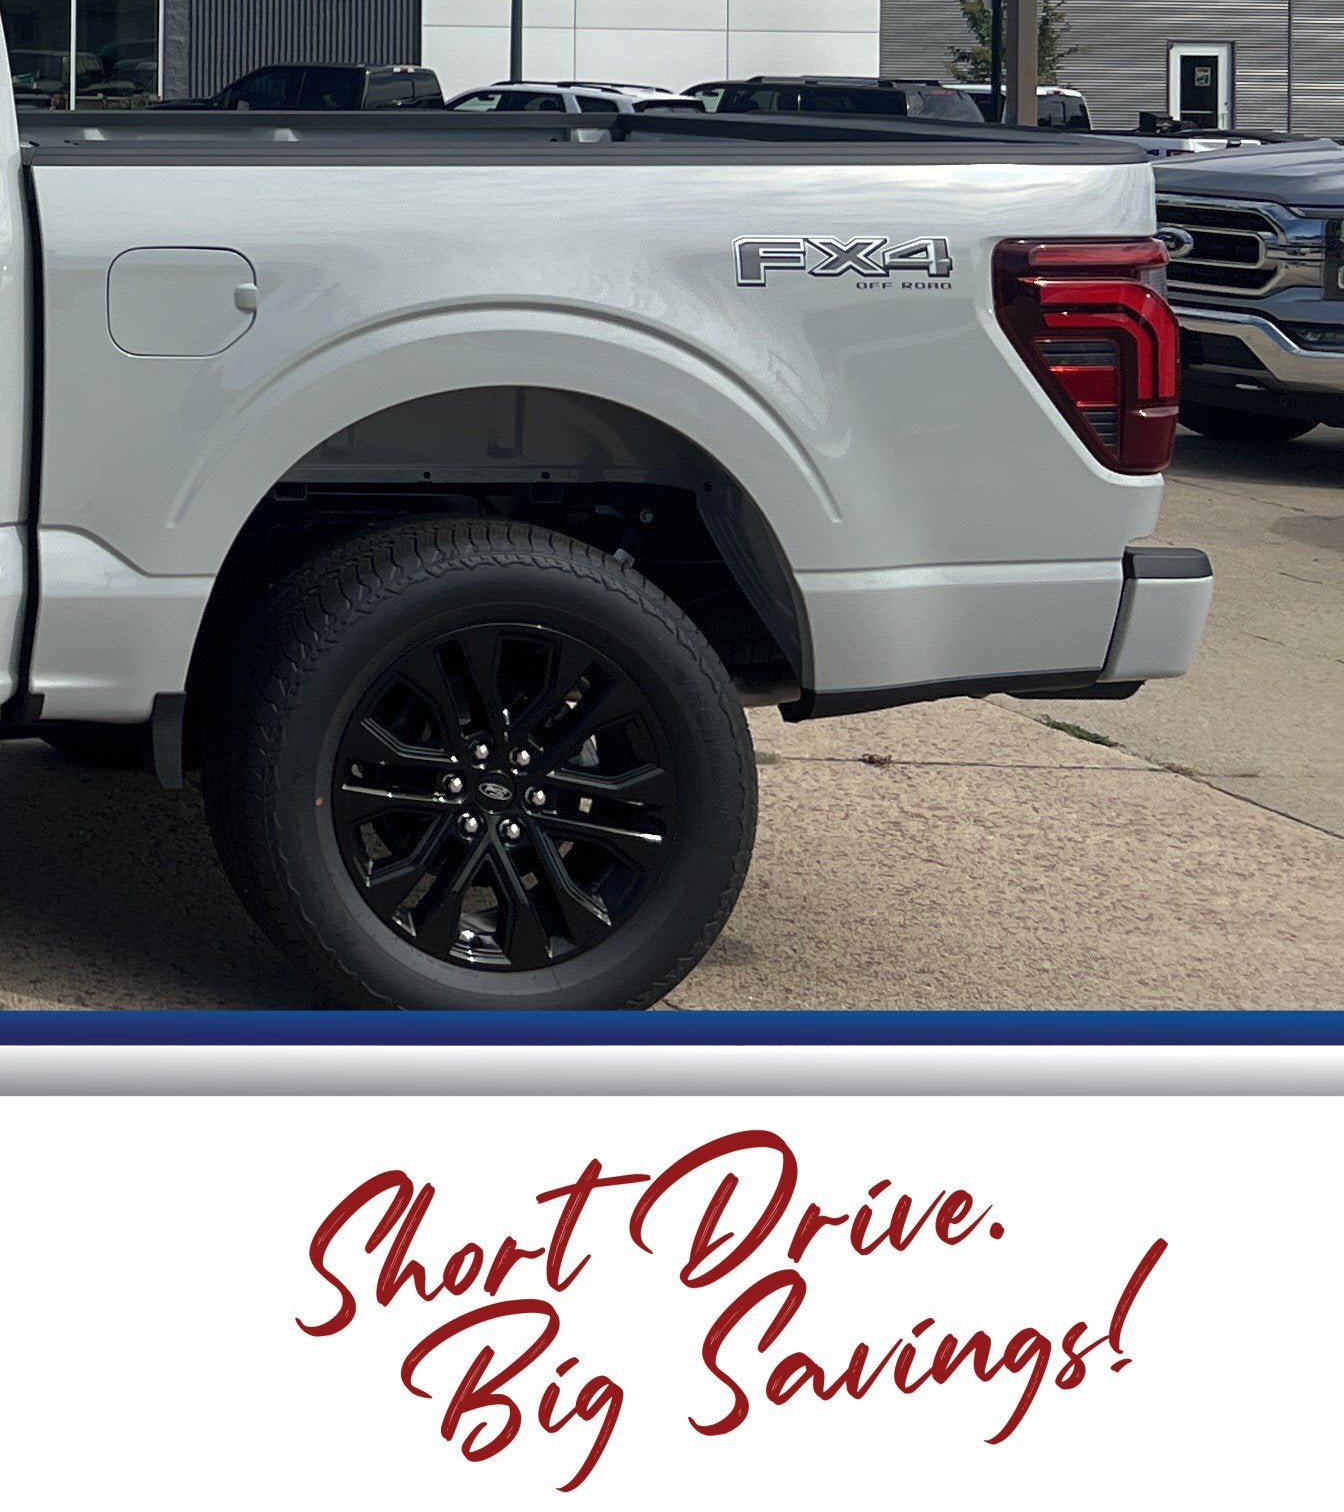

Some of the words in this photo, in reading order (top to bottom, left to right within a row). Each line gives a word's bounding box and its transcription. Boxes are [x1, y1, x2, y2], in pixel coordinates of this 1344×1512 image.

[733, 235, 953, 287] FX4
[856, 281, 893, 290] OFF
[901, 281, 953, 290] ROAD
